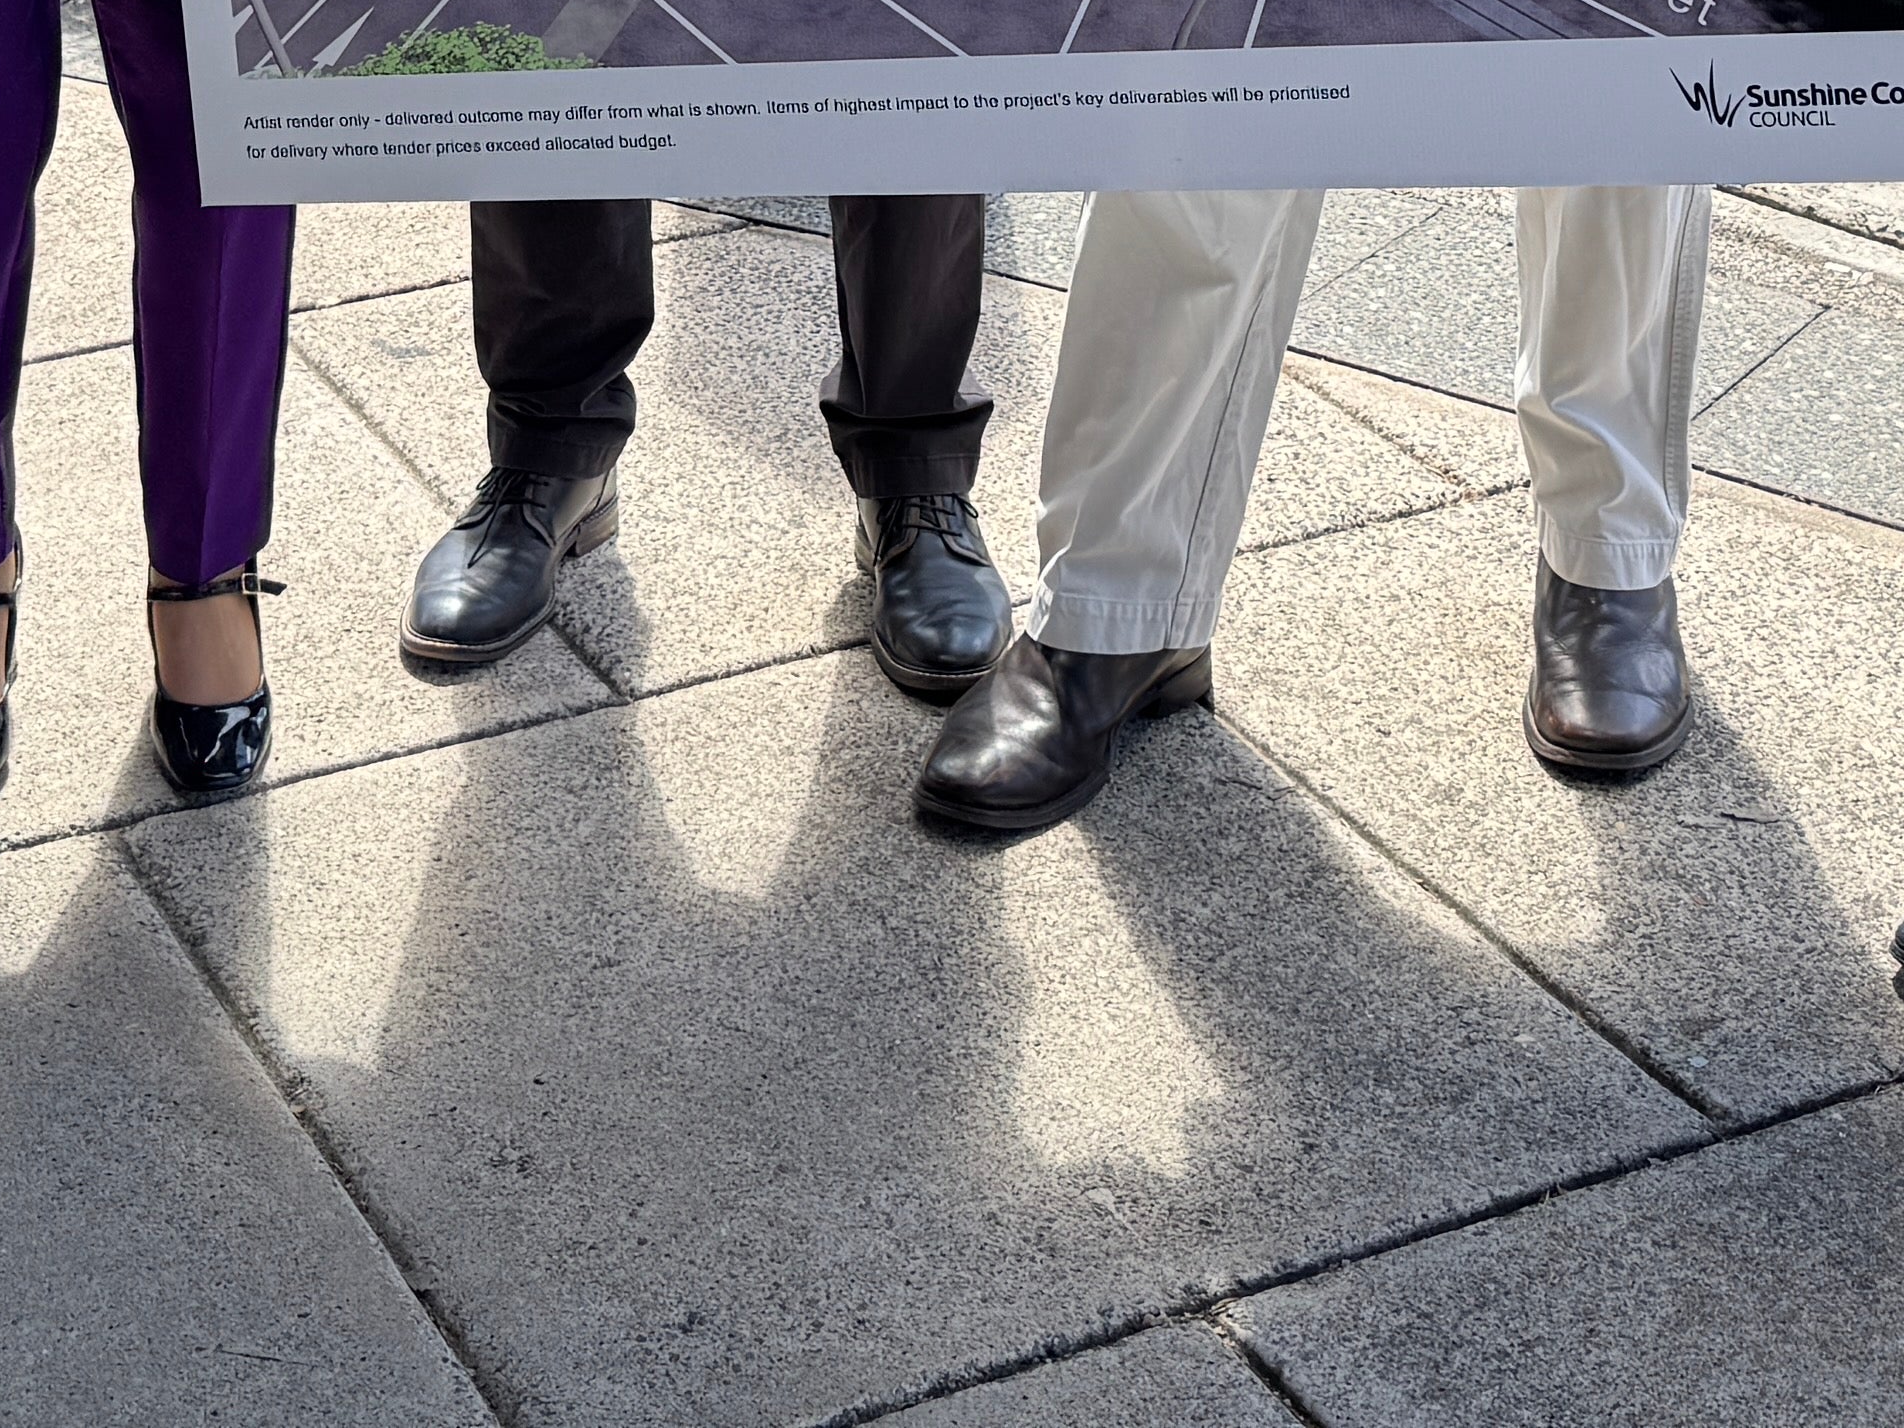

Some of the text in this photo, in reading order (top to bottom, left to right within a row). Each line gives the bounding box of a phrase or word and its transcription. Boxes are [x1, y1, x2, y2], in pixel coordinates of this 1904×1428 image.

[244, 84, 1351, 130] Artist render only delivered outcome may differ from what is shown. Items of highest impact to the project's key deliverables will be prioritised
[1746, 82, 1868, 107] Sunshine
[1749, 110, 1836, 128] COUNCIL
[247, 133, 677, 160] for delivery where tender prices exceed allocated budget.
